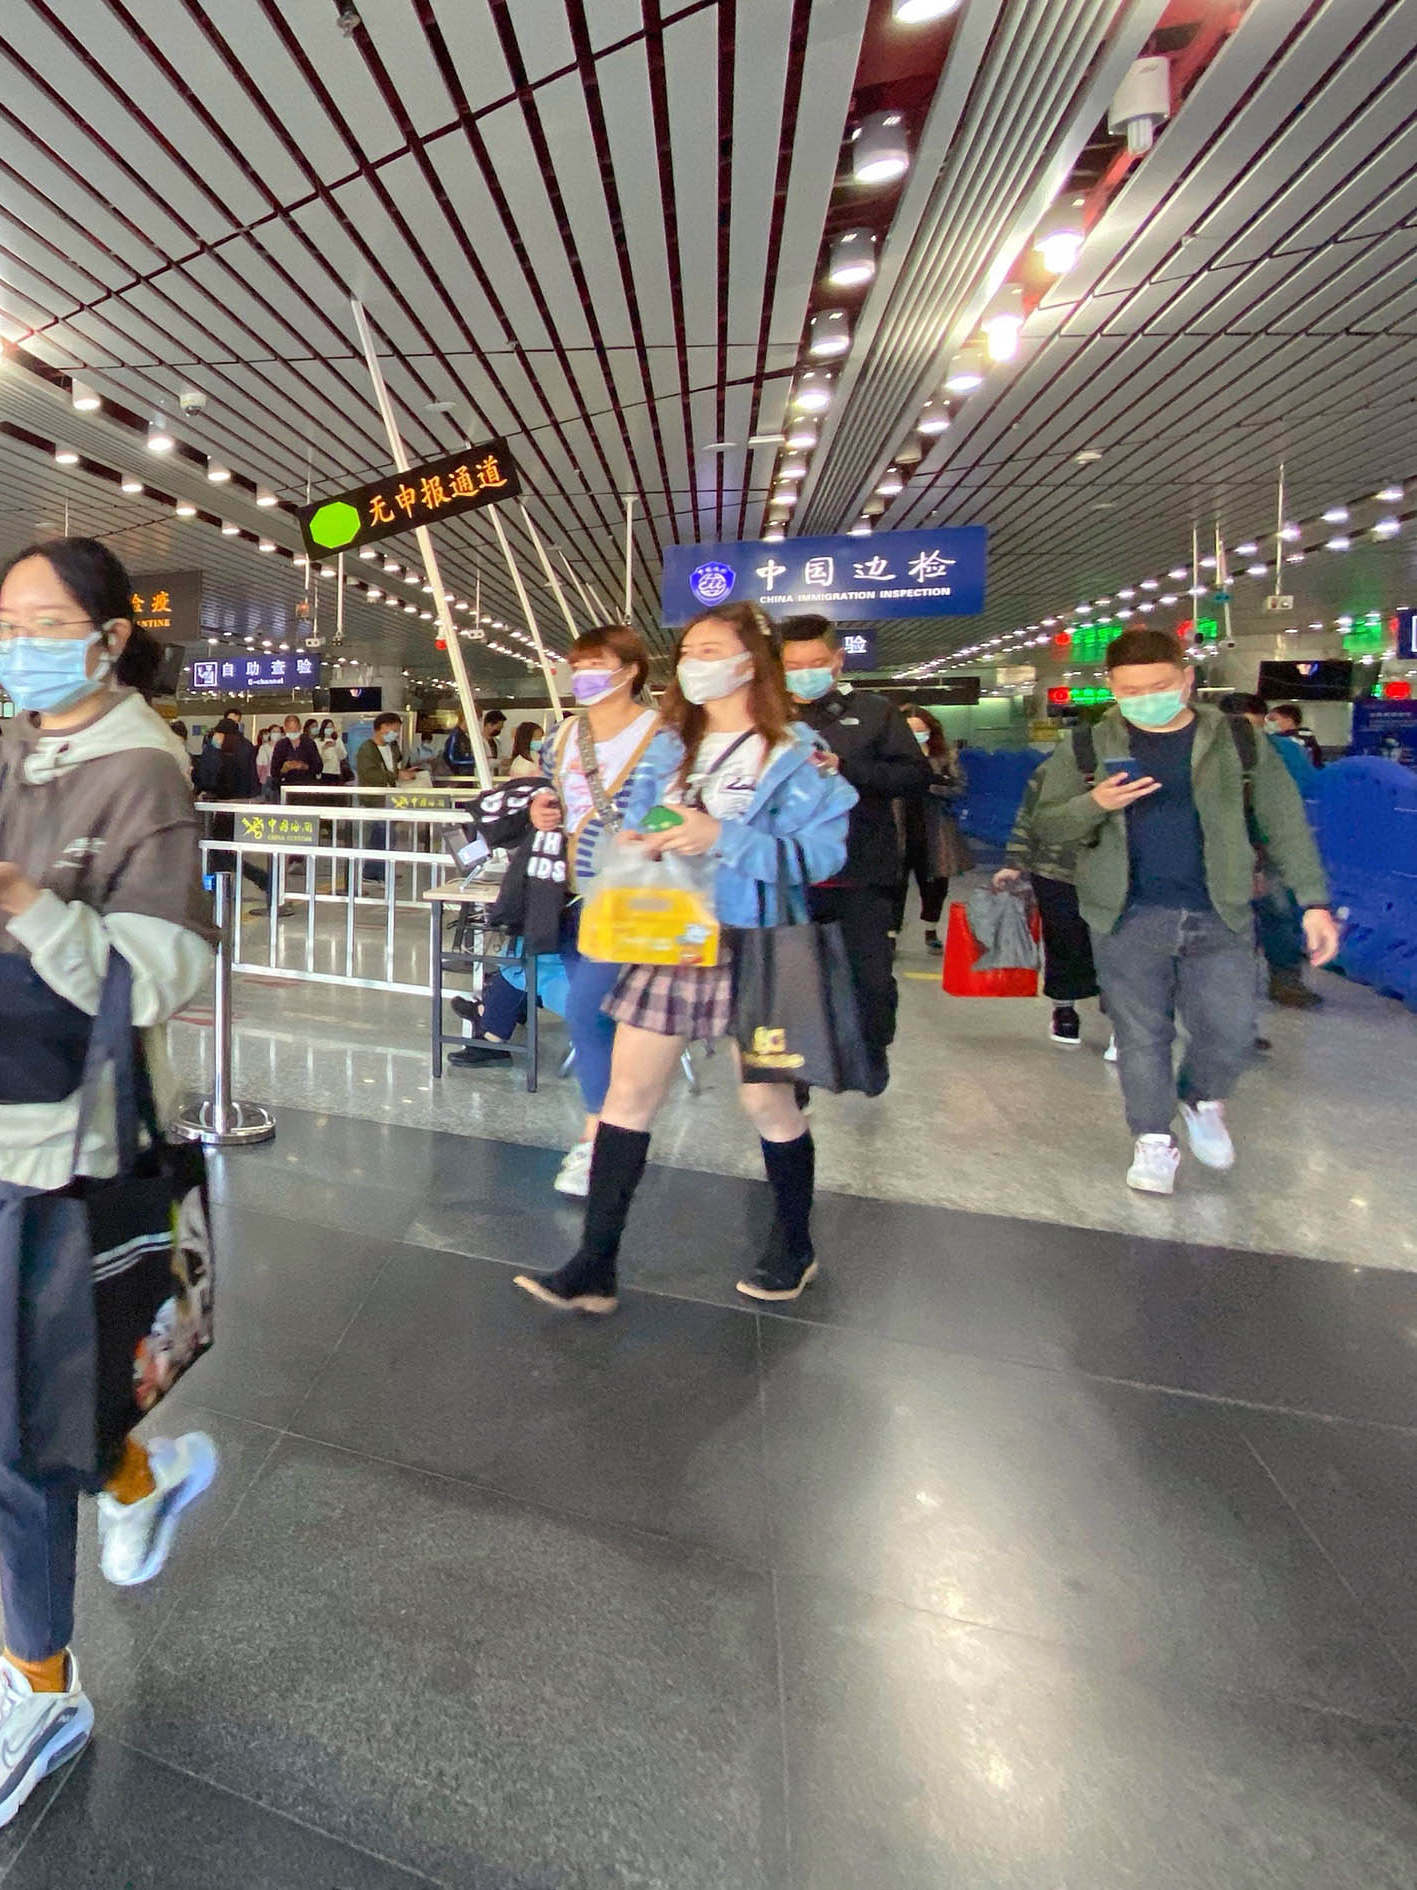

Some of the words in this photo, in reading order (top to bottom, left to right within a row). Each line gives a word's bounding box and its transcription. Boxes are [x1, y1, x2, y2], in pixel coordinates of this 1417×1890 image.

[368, 455, 508, 527] 无申报通道
[756, 549, 956, 591] 中国边检
[760, 595, 794, 604] CHINA
[798, 590, 875, 602] IMMIGRATION
[879, 587, 951, 598] INSPECTION
[222, 658, 313, 678] 自助查验
